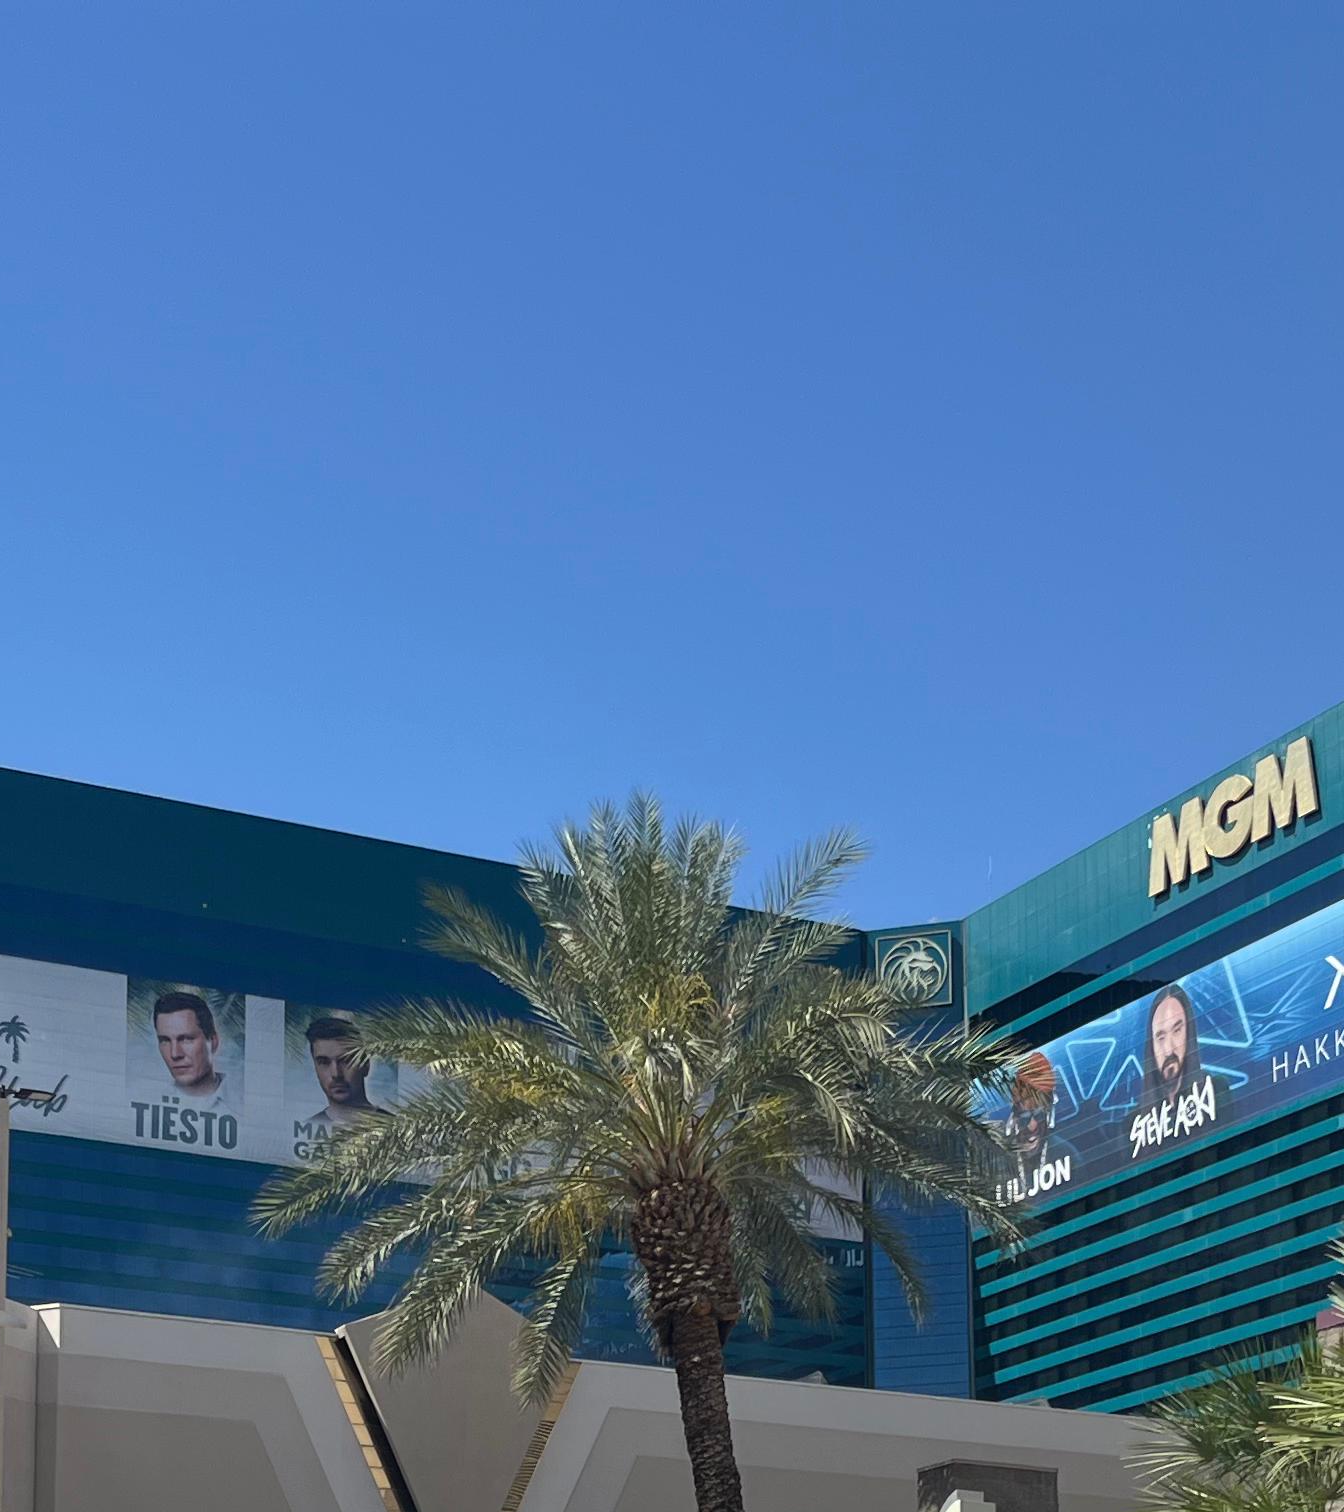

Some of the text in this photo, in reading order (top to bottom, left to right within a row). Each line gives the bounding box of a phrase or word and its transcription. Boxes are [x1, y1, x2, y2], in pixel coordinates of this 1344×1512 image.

[1148, 736, 1320, 899] MGM
[131, 1096, 238, 1150] TIËSTO
[1129, 1100, 1174, 1159] STEVE
[1027, 1156, 1071, 1197] JON
